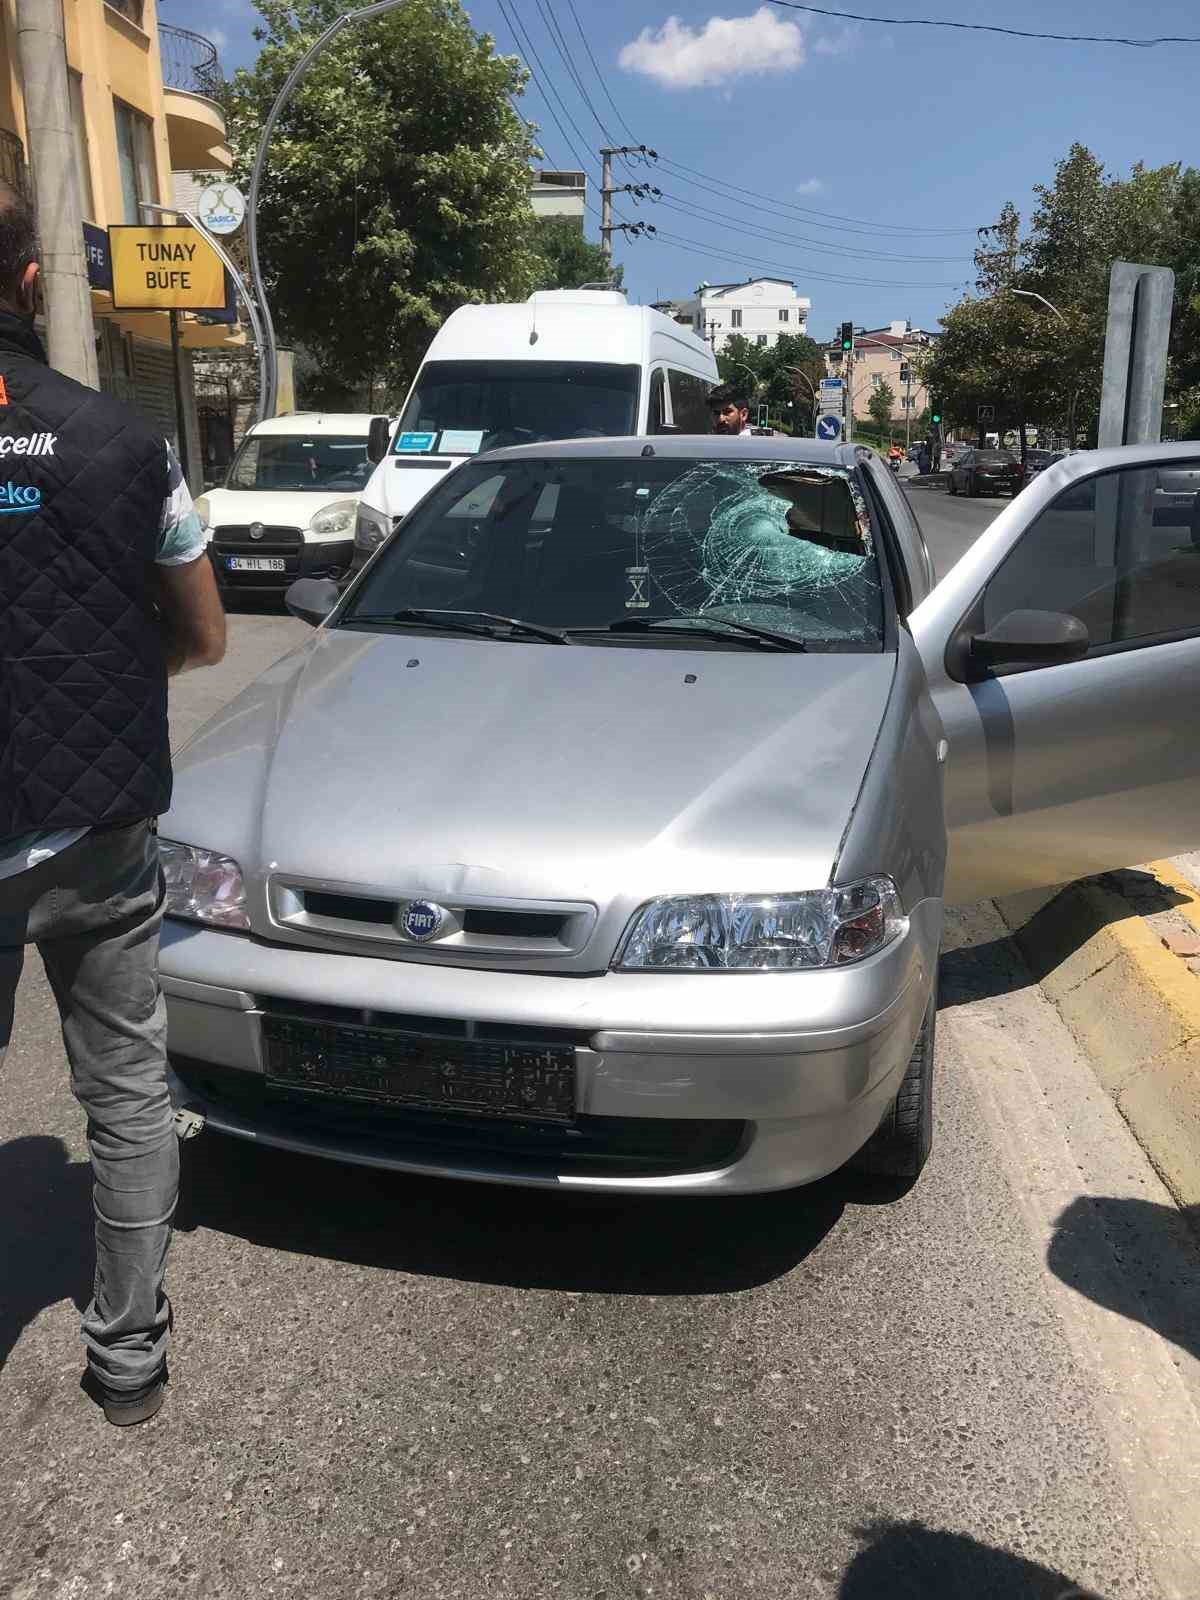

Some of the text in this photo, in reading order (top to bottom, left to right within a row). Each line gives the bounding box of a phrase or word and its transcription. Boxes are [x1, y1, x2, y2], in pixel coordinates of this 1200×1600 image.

[136, 243, 196, 261] TUNAY
[146, 266, 192, 289] BÜFE
[0, 432, 57, 458] çelik
[231, 559, 242, 569] 34
[247, 559, 262, 570] HIL
[408, 913, 433, 928] FIAT
